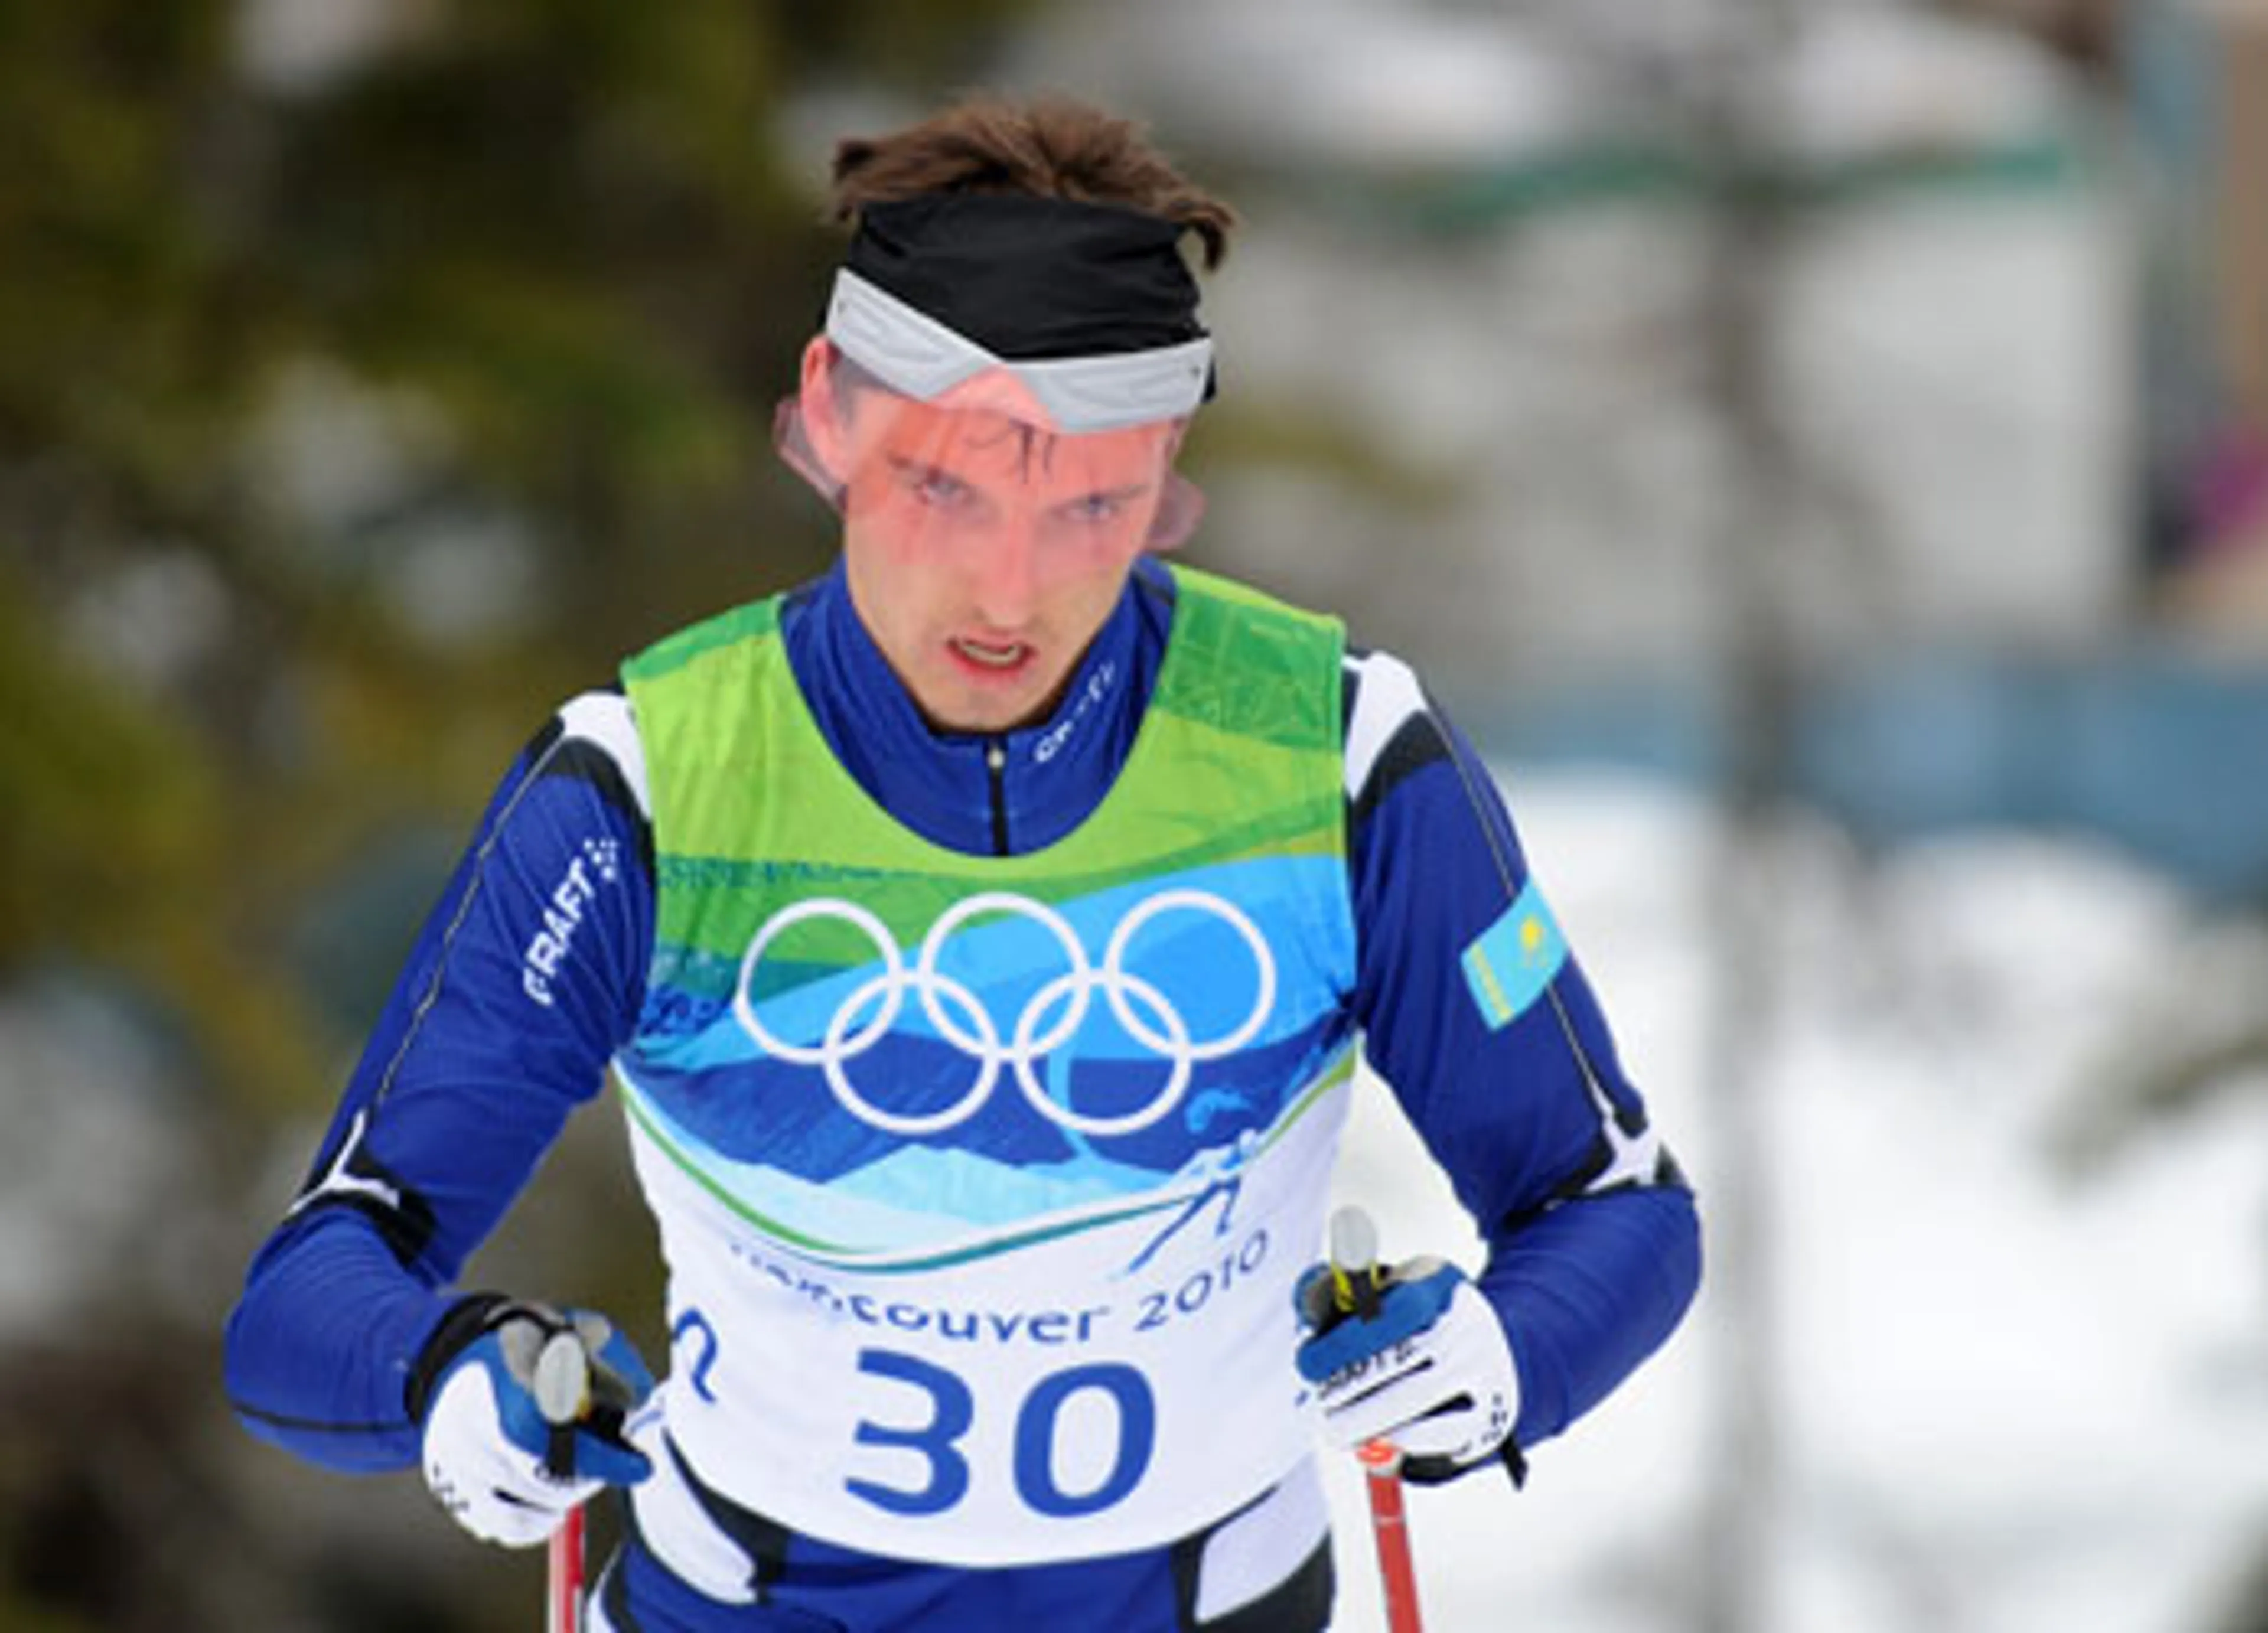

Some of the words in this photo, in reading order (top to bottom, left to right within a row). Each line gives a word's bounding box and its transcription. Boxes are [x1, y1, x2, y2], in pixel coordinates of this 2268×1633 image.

[523, 856, 594, 1006] CRAFT
[730, 1243, 1110, 1342] ncouver
[1135, 1228, 1268, 1331] 2010
[844, 1347, 1156, 1518] 30
